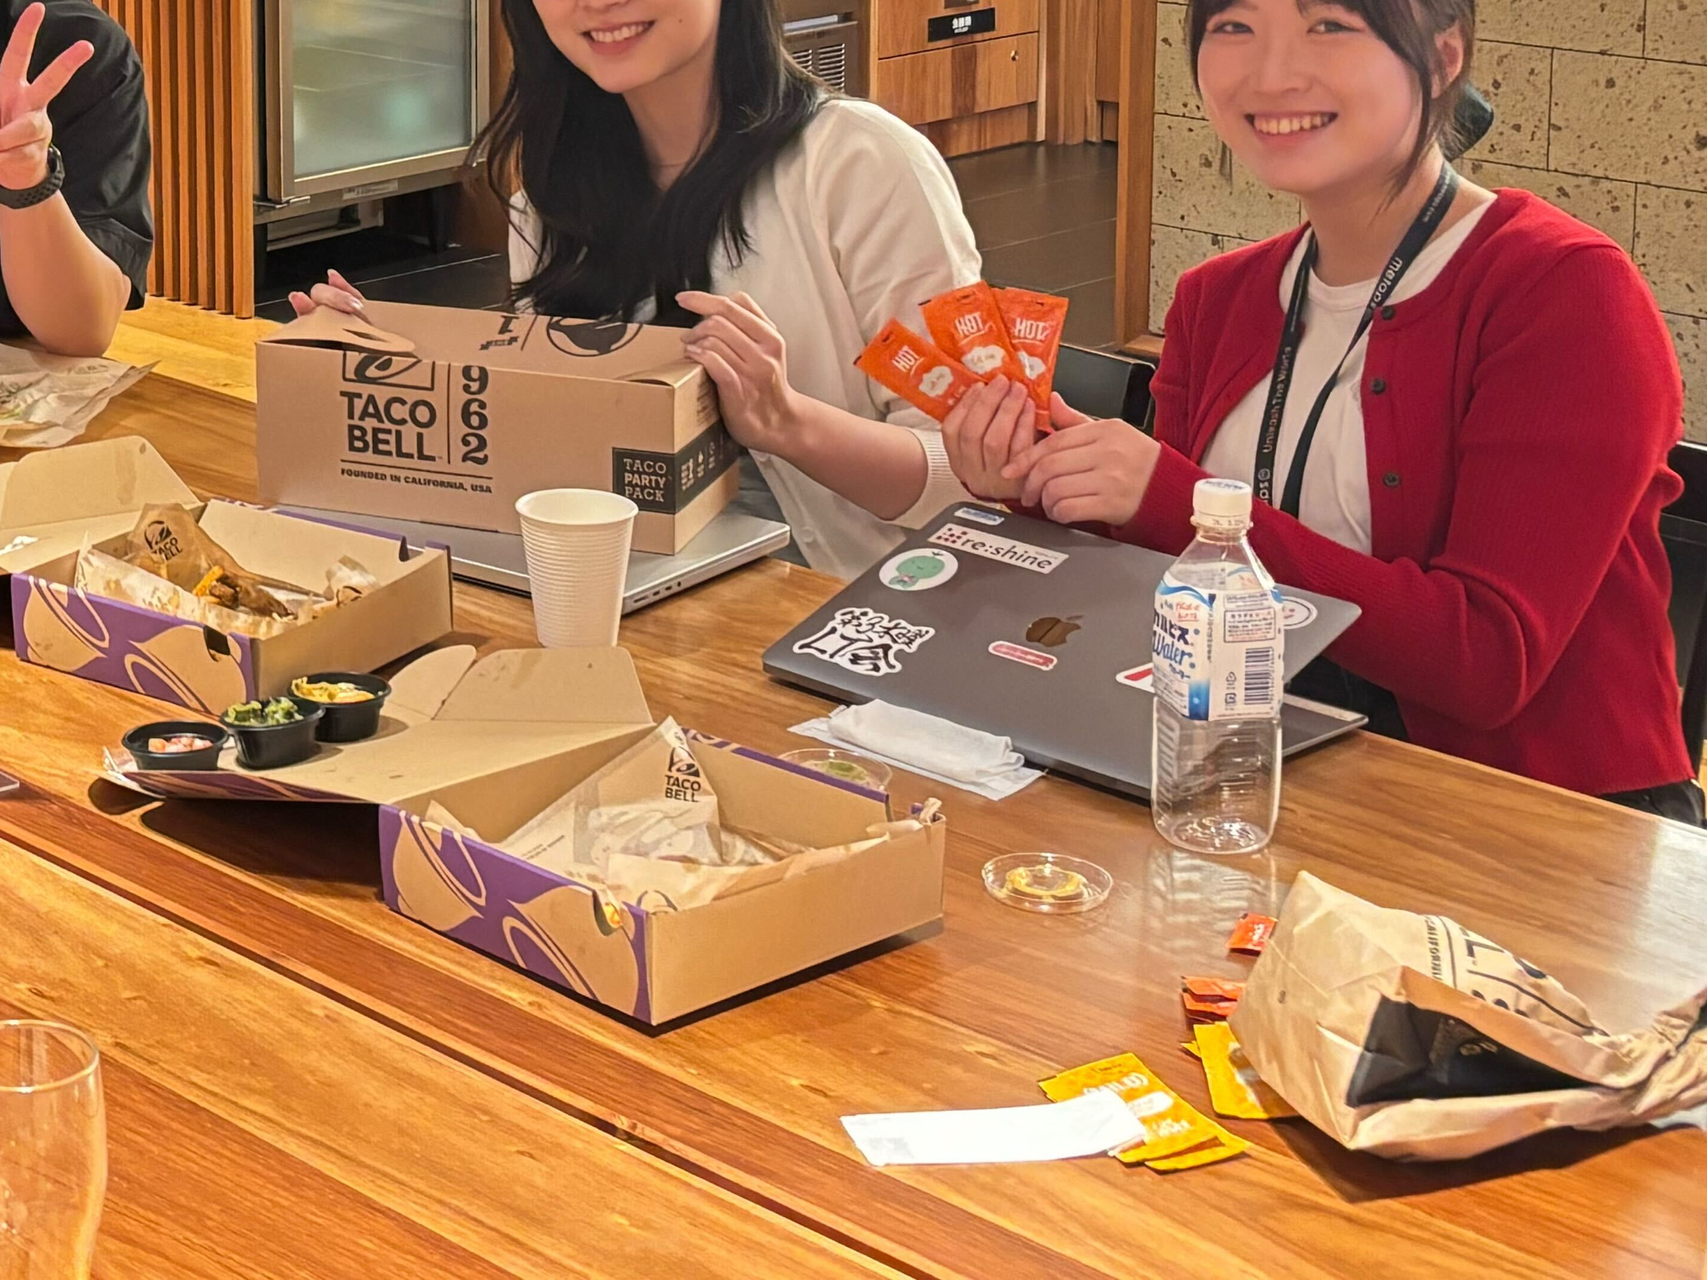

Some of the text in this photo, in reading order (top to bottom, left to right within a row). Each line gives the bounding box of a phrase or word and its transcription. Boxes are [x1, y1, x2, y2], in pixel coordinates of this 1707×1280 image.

[954, 312, 984, 337] HOT
[1015, 317, 1046, 339] HOT
[892, 344, 920, 372] HOT
[340, 390, 436, 428] TACO
[347, 424, 436, 462] BELL
[623, 458, 667, 474] TACO
[340, 467, 493, 493] FOUNDED IN CALIFORNIA, USA
[624, 472, 666, 488] PARTY
[625, 486, 665, 502] PACK
[151, 537, 178, 556] ACO
[961, 538, 1053, 569] re:shine
[1153, 630, 1192, 666] Water
[664, 774, 701, 792] TACO
[664, 787, 700, 803] BELL
